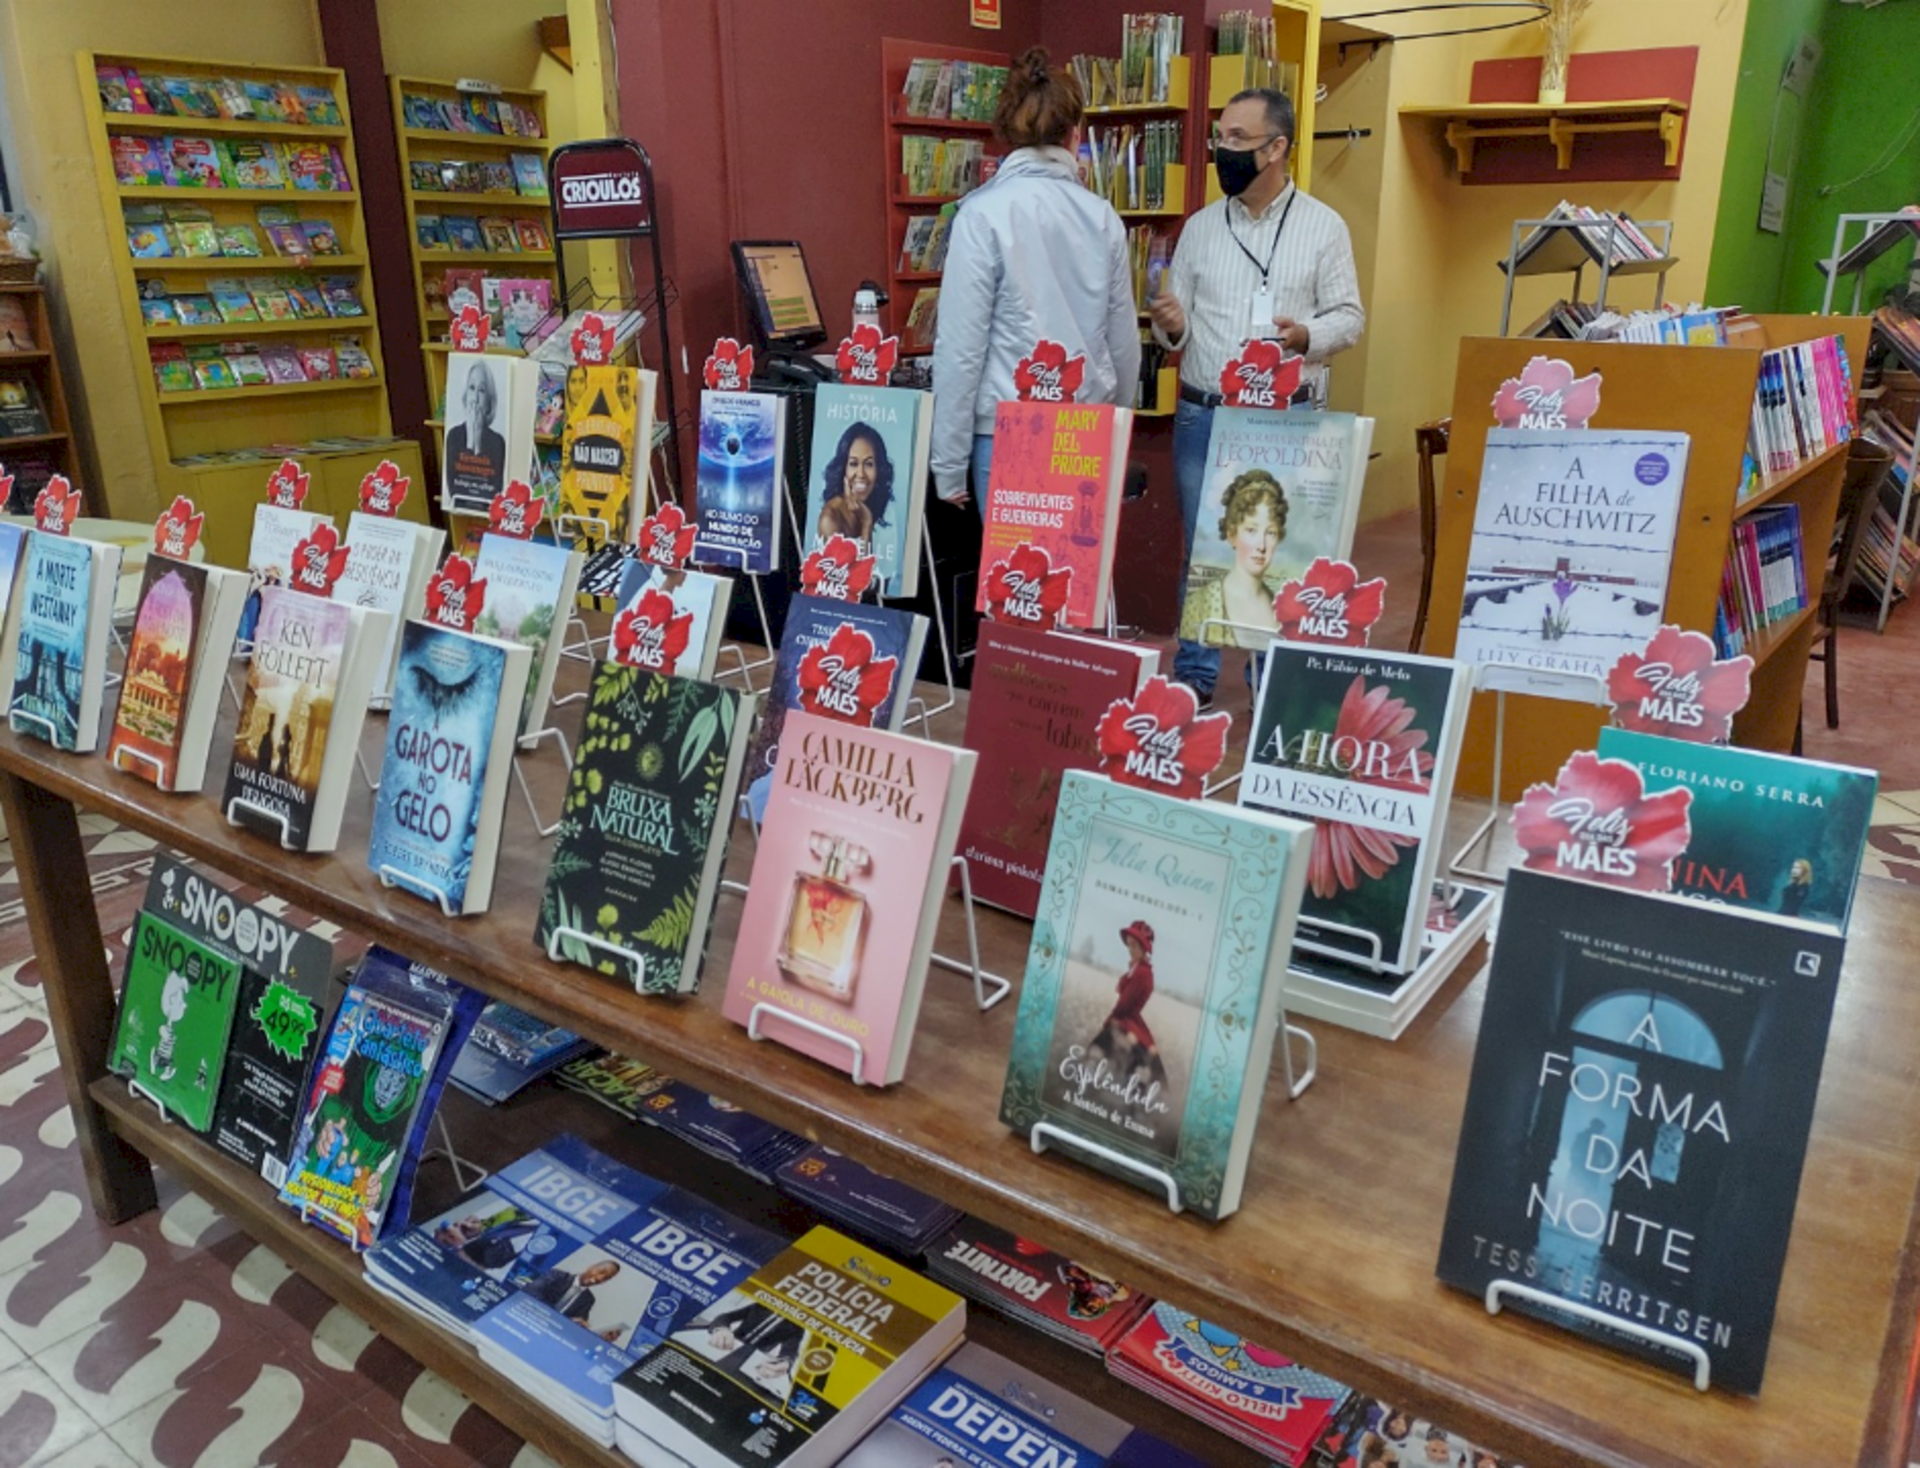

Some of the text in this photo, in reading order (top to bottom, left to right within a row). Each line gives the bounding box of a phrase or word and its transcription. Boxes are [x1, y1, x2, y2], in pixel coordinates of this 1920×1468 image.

[562, 177, 641, 203] CRIOULOS
[827, 402, 898, 424] HISTÓRIA
[1055, 409, 1100, 432] MARY
[1053, 432, 1080, 453] DEL
[1214, 442, 1342, 470] LEOPOLDINA
[1051, 454, 1102, 477] PRIORE
[1566, 456, 1584, 480] A
[994, 489, 1074, 511] SOBREVIVENTES
[1535, 482, 1636, 508] FILHA de
[992, 508, 1064, 529] E GUERREIRAS
[1493, 502, 1657, 535] AUSCHWITZ
[813, 533, 894, 561] MELLE
[36, 558, 76, 590] A MORTE
[279, 618, 315, 650] KEN
[257, 641, 329, 689] FOLLETT
[1326, 657, 1358, 676] Fábio
[1360, 664, 1377, 677] de
[1380, 665, 1411, 683] Melo
[1477, 647, 1519, 663] LILY
[1528, 654, 1603, 677] GRAHA
[1634, 662, 1704, 702] Feliz
[395, 723, 472, 786] GAROTA
[803, 731, 916, 789] CAMILLA
[1257, 723, 1425, 786] A HORA
[258, 772, 306, 804] FORTUNA
[417, 770, 437, 795] NO
[784, 757, 924, 824] LÄCKBERG
[1252, 773, 1416, 828] DA ESSÊNCIA
[1637, 762, 1825, 809] FLORIANO SERRA
[395, 790, 452, 843] GELO
[607, 785, 672, 827] BRUXA
[1546, 797, 1634, 848] Feliz
[589, 804, 679, 856] NATURAL
[1092, 836, 1217, 895] Julia Quinn
[1556, 840, 1637, 876] MÃES
[181, 876, 300, 975] SNOOPY
[142, 924, 231, 1002] SNOOPY
[1594, 938, 1629, 954] LIVRO
[1632, 947, 1653, 960] VAI
[409, 962, 448, 986] MARVEL
[747, 976, 756, 990] A
[1626, 1012, 1664, 1053] A
[1059, 1044, 1170, 1115] Esplêndida
[1063, 1092, 1072, 1102] A
[1538, 1050, 1731, 1143] FORMA
[1583, 1134, 1652, 1190] DA
[519, 1165, 619, 1227] IBGE
[1526, 1182, 1696, 1274] NOITE
[629, 1217, 742, 1287] IBGE
[944, 1239, 1052, 1302] FORTNITE
[774, 1274, 877, 1341] FEDERAL
[797, 1262, 894, 1323] POLÍCIA
[1473, 1235, 1539, 1279] TESS
[1559, 1266, 1732, 1350] GERRITSEN
[754, 1290, 866, 1356] ESCRIVÃO DE POLÍCIA
[1179, 1369, 1283, 1418] HELLO KITTY
[1187, 1357, 1249, 1391] AMIGOS
[900, 1413, 934, 1437] AGENTE
[932, 1428, 968, 1457] FEDERAL
[928, 1386, 1079, 1468] DEPEN
